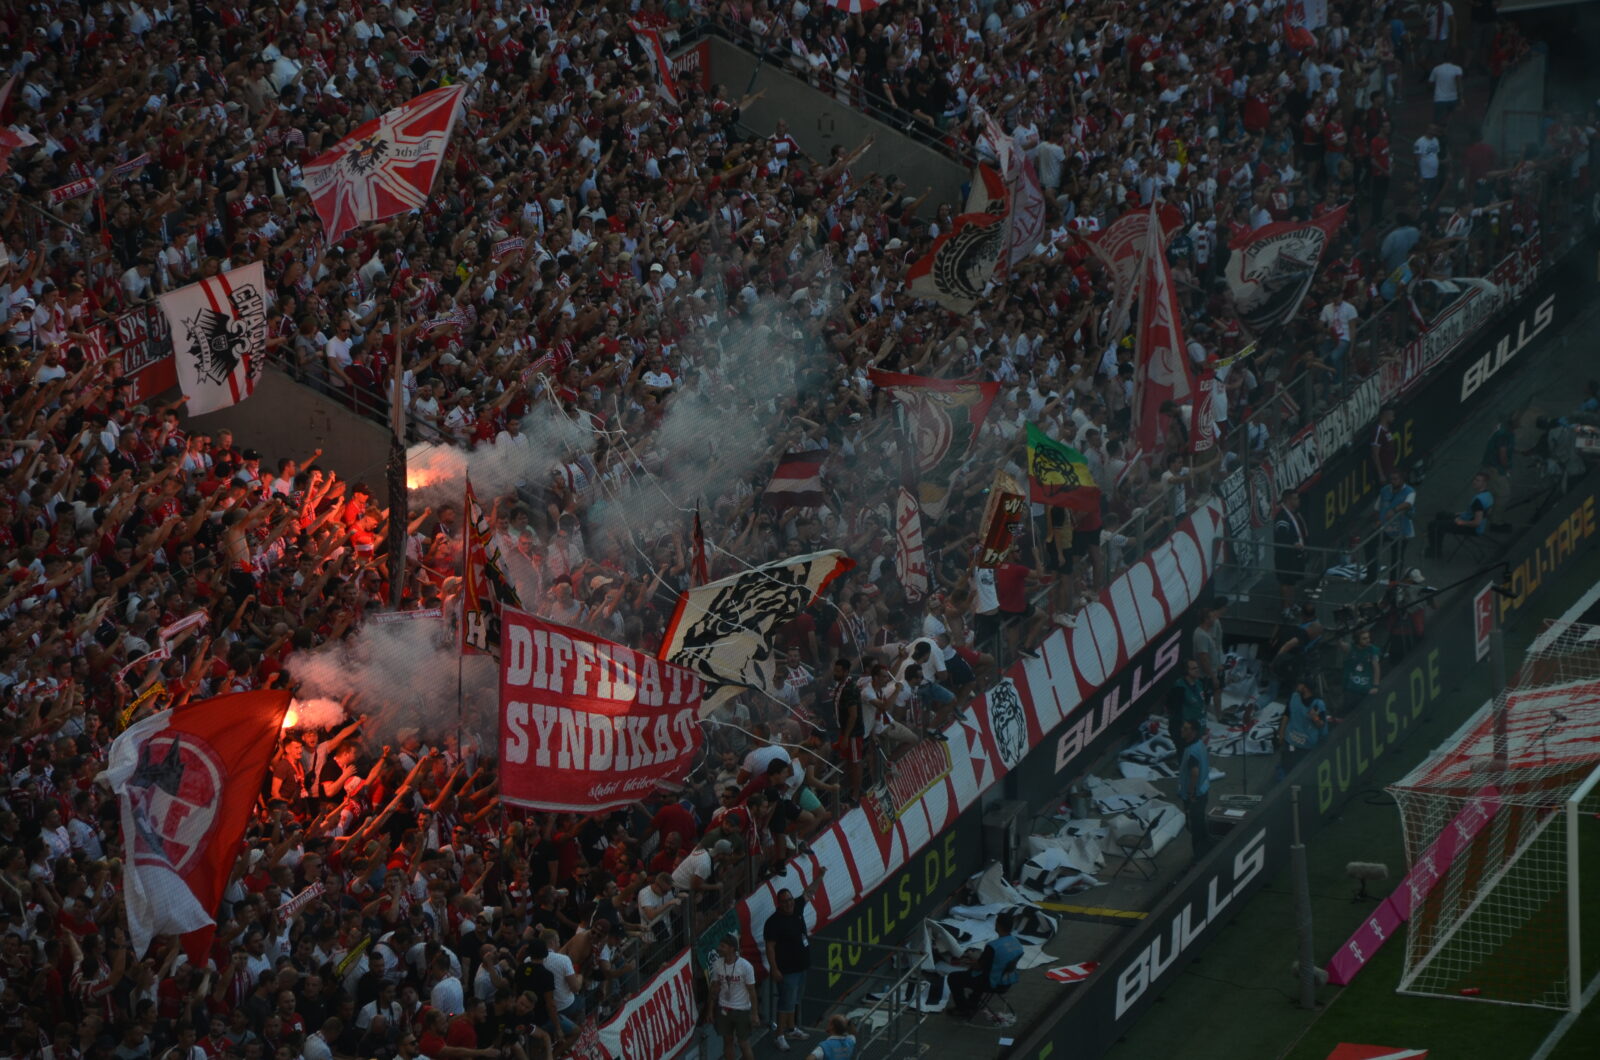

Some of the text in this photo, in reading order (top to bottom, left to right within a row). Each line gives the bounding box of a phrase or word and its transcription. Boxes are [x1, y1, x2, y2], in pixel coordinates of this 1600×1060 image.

[1461, 293, 1556, 402] BULLS
[1022, 497, 1225, 737] HORDE
[505, 701, 697, 772] SYNDIKAT
[1054, 630, 1182, 774] BULLS
[1317, 648, 1441, 815] BULLS.DE
[828, 831, 957, 988] BULLS.DE
[1114, 827, 1266, 1022] BULLS
